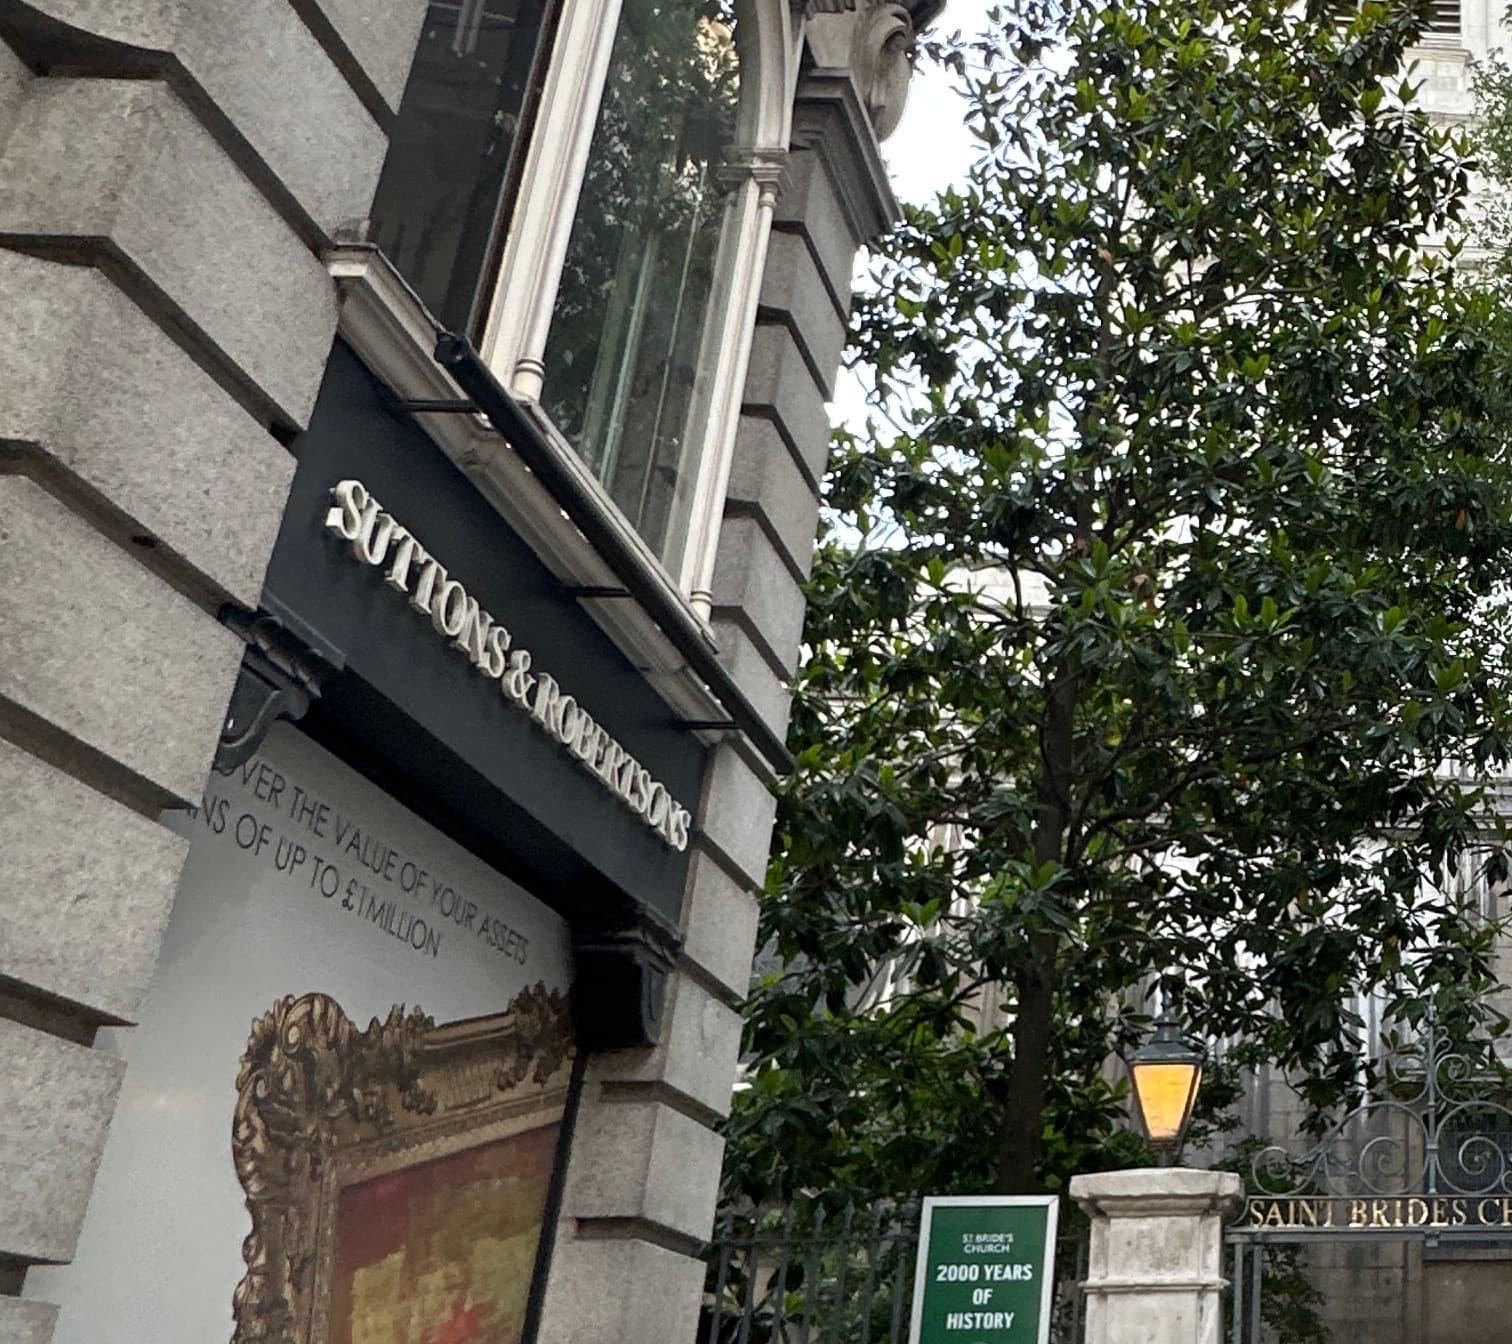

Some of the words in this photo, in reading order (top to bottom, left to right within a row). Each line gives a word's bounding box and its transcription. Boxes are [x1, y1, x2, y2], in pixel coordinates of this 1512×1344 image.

[325, 479, 510, 678] SUTTONS
[502, 649, 536, 711] &
[529, 672, 692, 852] ROBERTSONS
[235, 813, 273, 856] OF
[275, 835, 306, 876] UP
[310, 856, 340, 898] TO
[289, 785, 331, 838] THE
[336, 813, 399, 883] VALUE
[400, 861, 430, 897] OF
[432, 875, 478, 932] YOUR
[477, 912, 529, 967] ASSETS
[1249, 1198, 1335, 1228] SAINT
[1348, 1197, 1467, 1228] BRIDES
[963, 1243, 1011, 1254] CHURCH
[936, 1264, 980, 1282] 2000
[983, 1263, 1033, 1282] YEARS
[972, 1288, 994, 1305] OF
[946, 1312, 1015, 1331] HISTORY
